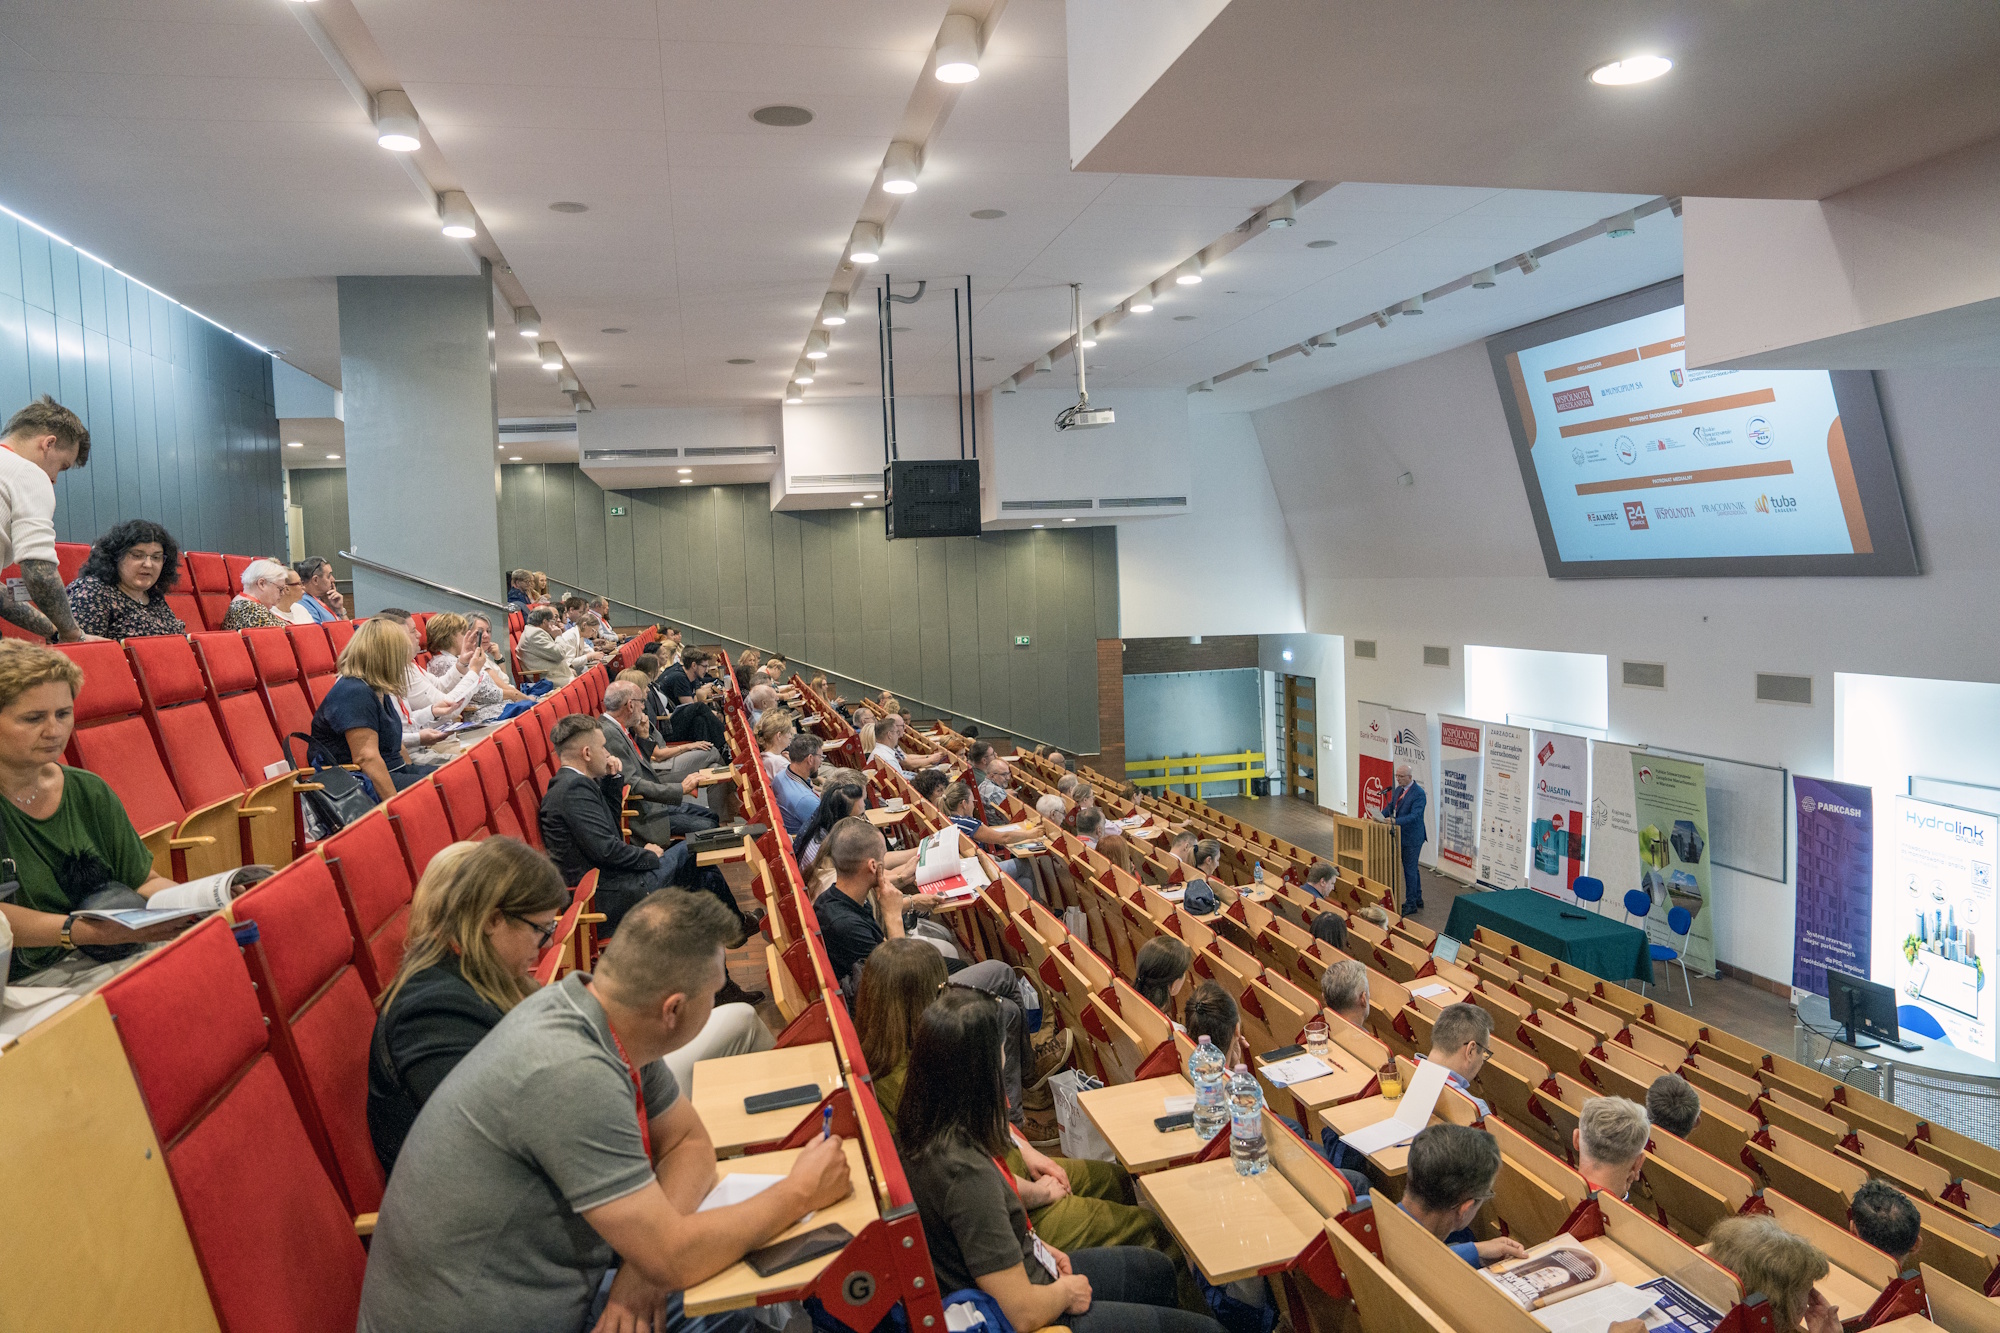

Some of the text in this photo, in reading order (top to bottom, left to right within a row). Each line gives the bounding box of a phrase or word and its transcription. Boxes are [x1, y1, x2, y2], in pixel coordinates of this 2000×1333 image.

[1605, 382, 1643, 396] MUNICIPIUM SA
[1555, 390, 1591, 404] WSPÓLNOTA
[1557, 399, 1592, 411] MIESZKANIOWA
[1629, 408, 1683, 423] PATRONAT ŚRODOWISKOWY
[1702, 502, 1746, 513] PRACOWNIK
[1770, 495, 1796, 508] tuba
[1587, 511, 1619, 522] REALNOŚĆ
[1626, 505, 1647, 520] 24
[1654, 507, 1696, 520] WSPÓLNOTA
[1370, 733, 1388, 745] Pocztowy
[1443, 727, 1478, 742] WSPÓLNOTA
[1443, 736, 1478, 750] MIESZKANIOWA
[1394, 745, 1409, 757] ZBM
[1414, 749, 1425, 760] TBS
[1537, 779, 1571, 797] AQUASATIN
[1817, 802, 1862, 817] PARKCASH
[1906, 810, 1984, 840] Hydrolink
[1955, 834, 1984, 846] ONLINE
[1806, 930, 1852, 949] System rezerwacji
[1803, 937, 1855, 958] miejsc parkingowych
[1803, 957, 1827, 969] spółdzielni
[1844, 963, 1865, 974] wspólnot
[849, 1276, 870, 1299] G
